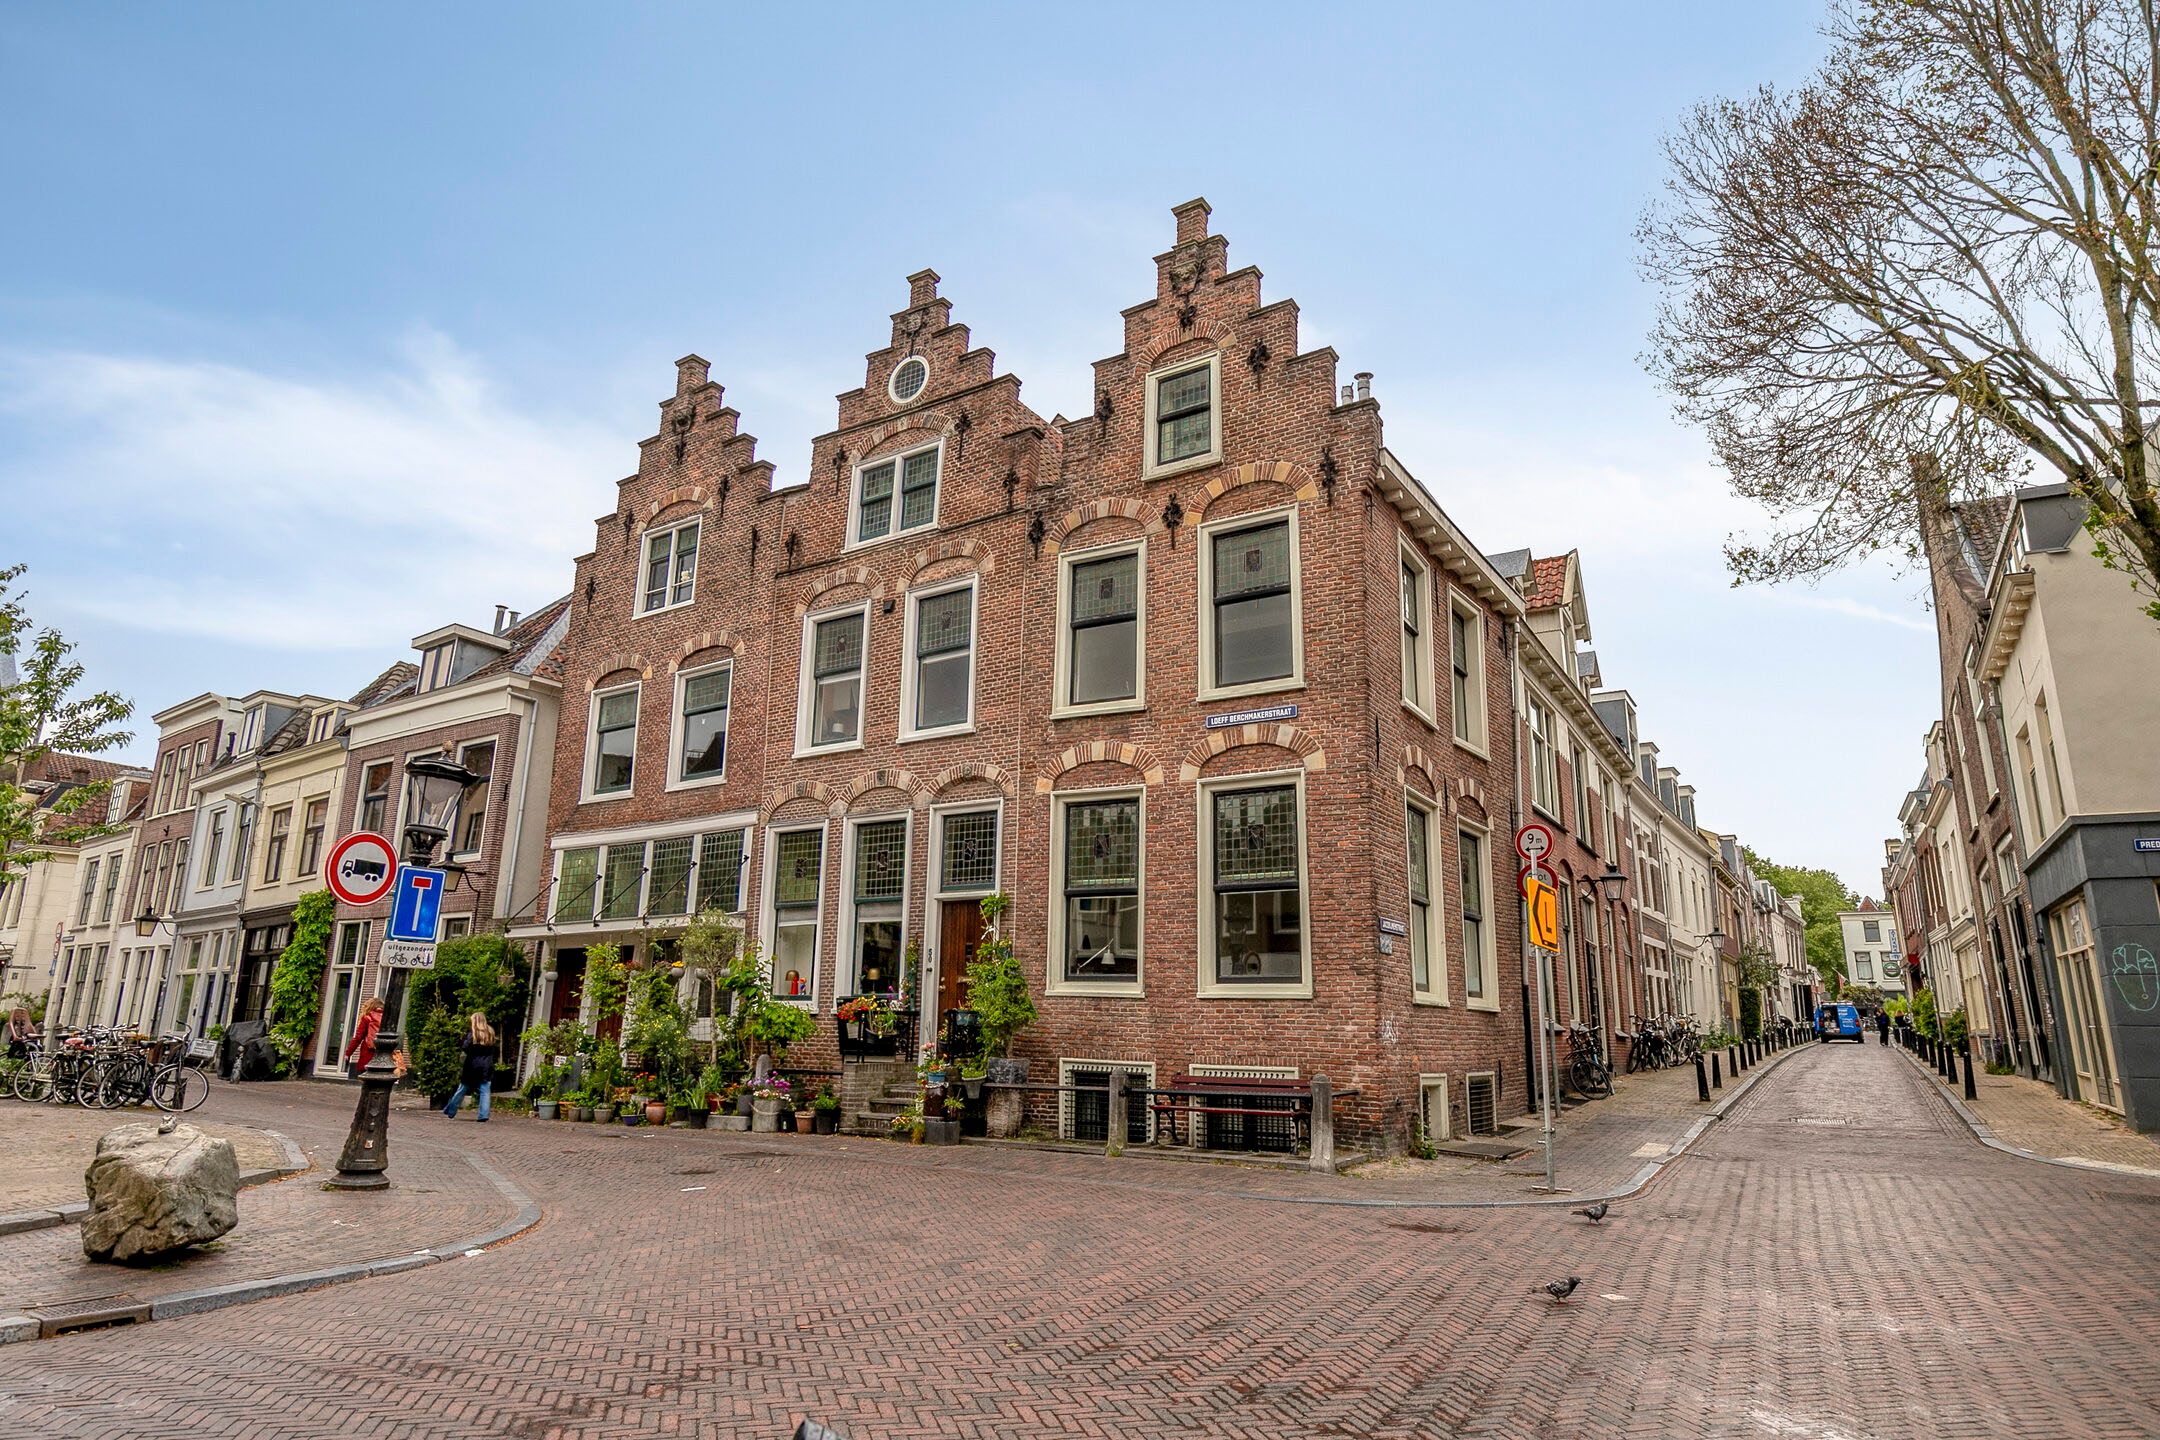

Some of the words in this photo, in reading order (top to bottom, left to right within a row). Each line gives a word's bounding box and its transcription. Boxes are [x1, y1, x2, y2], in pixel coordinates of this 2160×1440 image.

[1210, 716, 1229, 725] LOEFF
[1229, 708, 1292, 723] BERCHMAKERSTRAAT
[1527, 833, 1534, 844] 9
